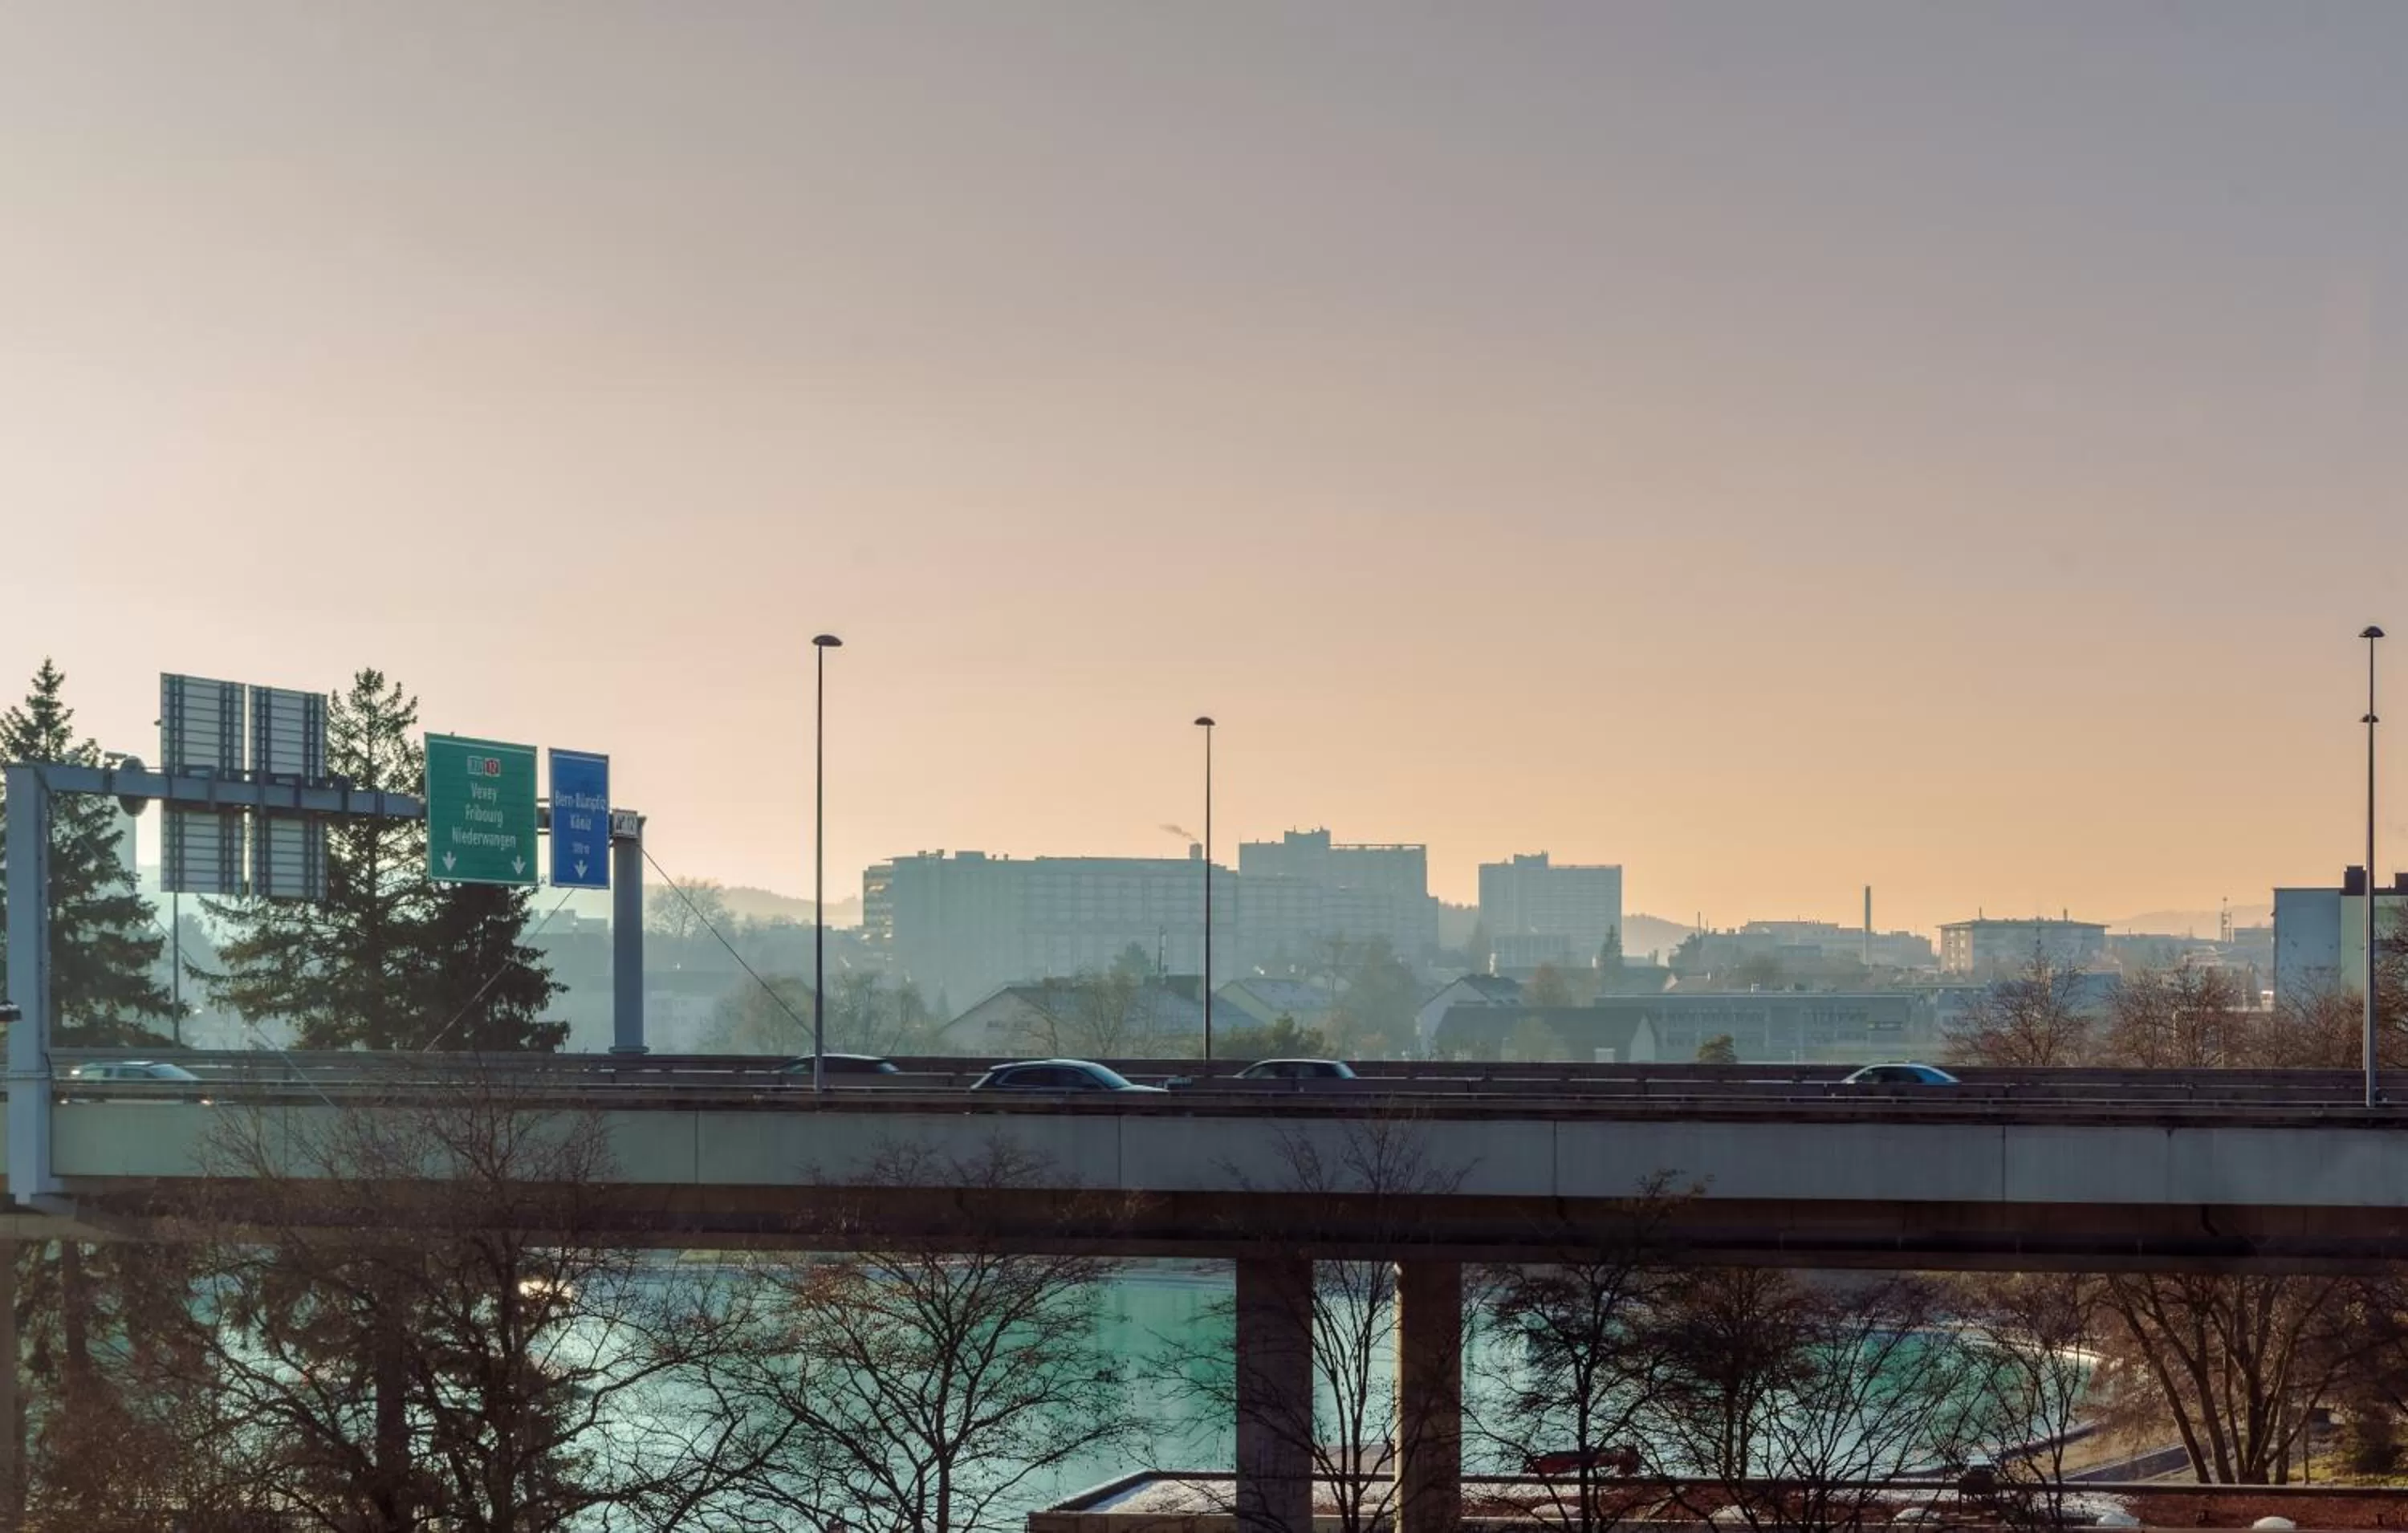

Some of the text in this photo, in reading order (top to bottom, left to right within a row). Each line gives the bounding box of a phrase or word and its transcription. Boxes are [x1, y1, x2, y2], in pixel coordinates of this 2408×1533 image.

[471, 783, 497, 805] Vevey
[465, 804, 503, 828] Fribourg
[452, 827, 516, 851] Niederwangen
